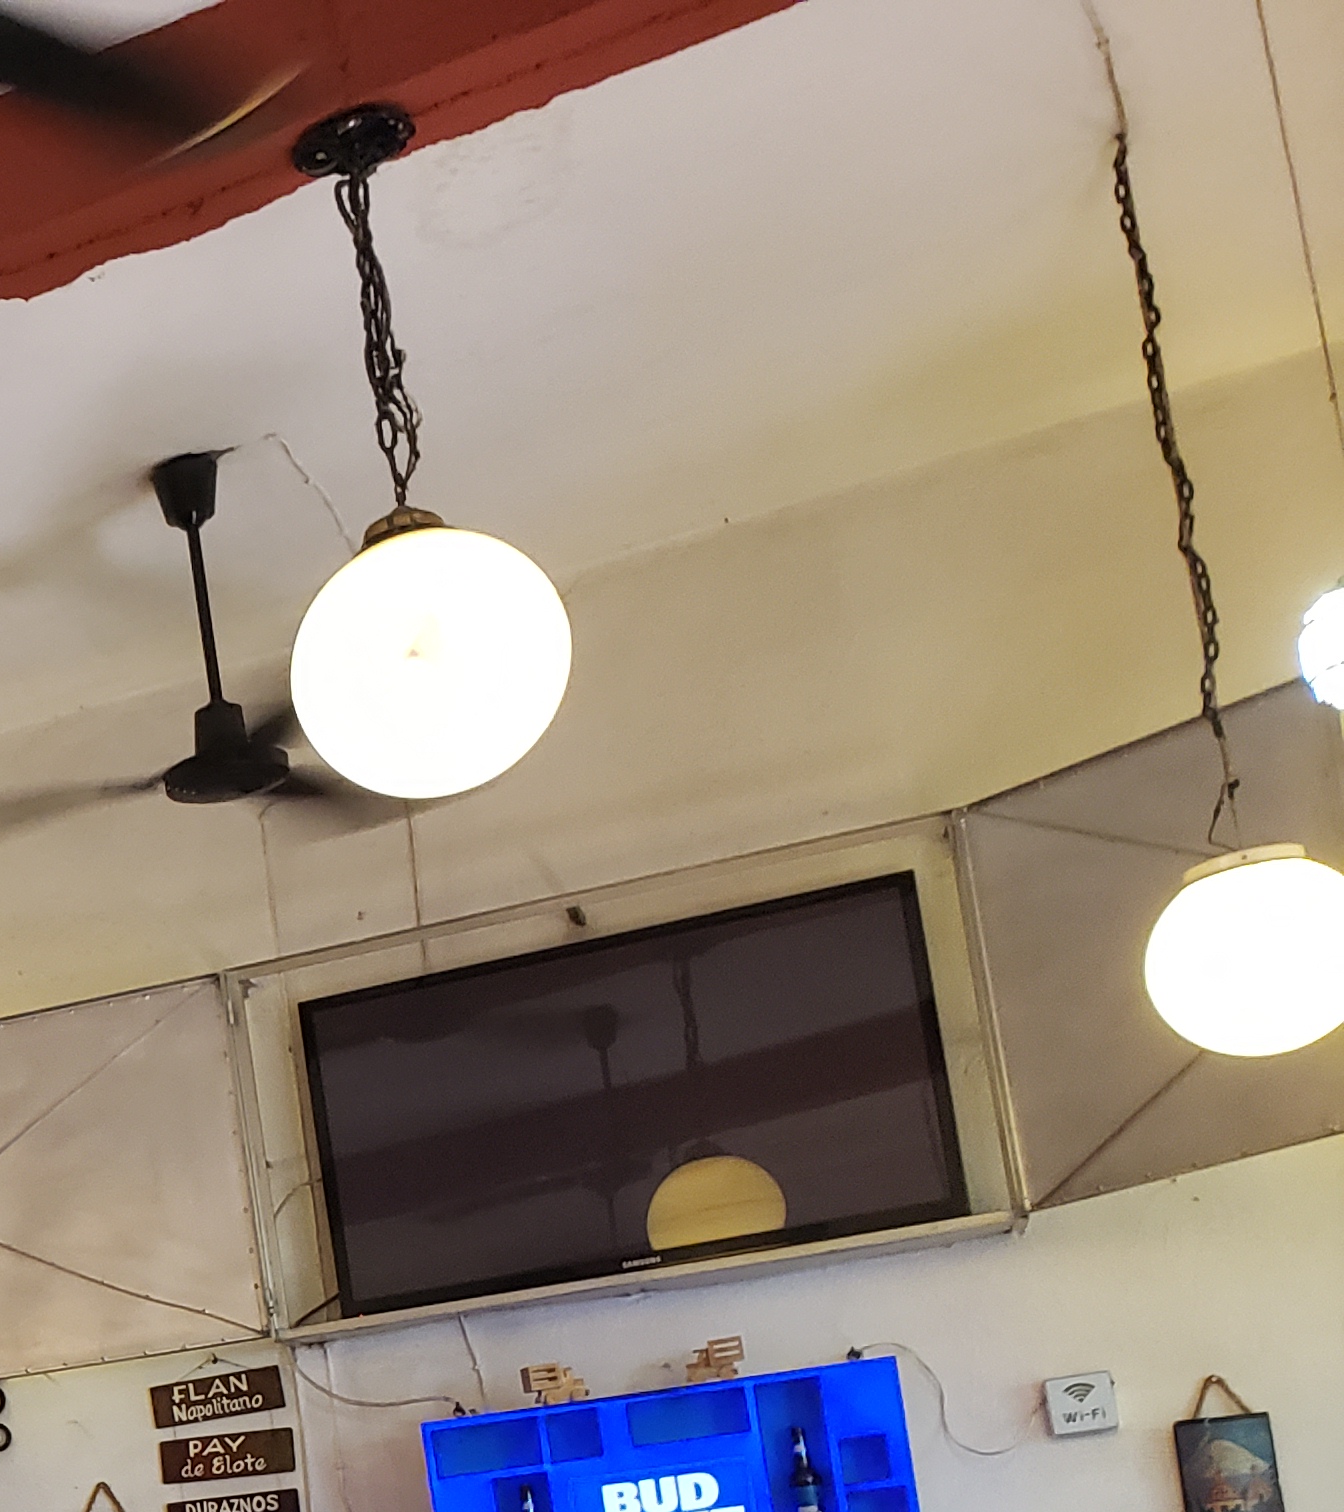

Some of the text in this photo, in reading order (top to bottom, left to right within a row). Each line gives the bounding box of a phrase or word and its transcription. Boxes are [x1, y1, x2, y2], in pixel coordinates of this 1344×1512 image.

[172, 1373, 249, 1404] FLAN
[172, 1394, 264, 1422] Napolitano
[188, 1435, 246, 1458] PAY
[181, 1453, 268, 1478] de Elote
